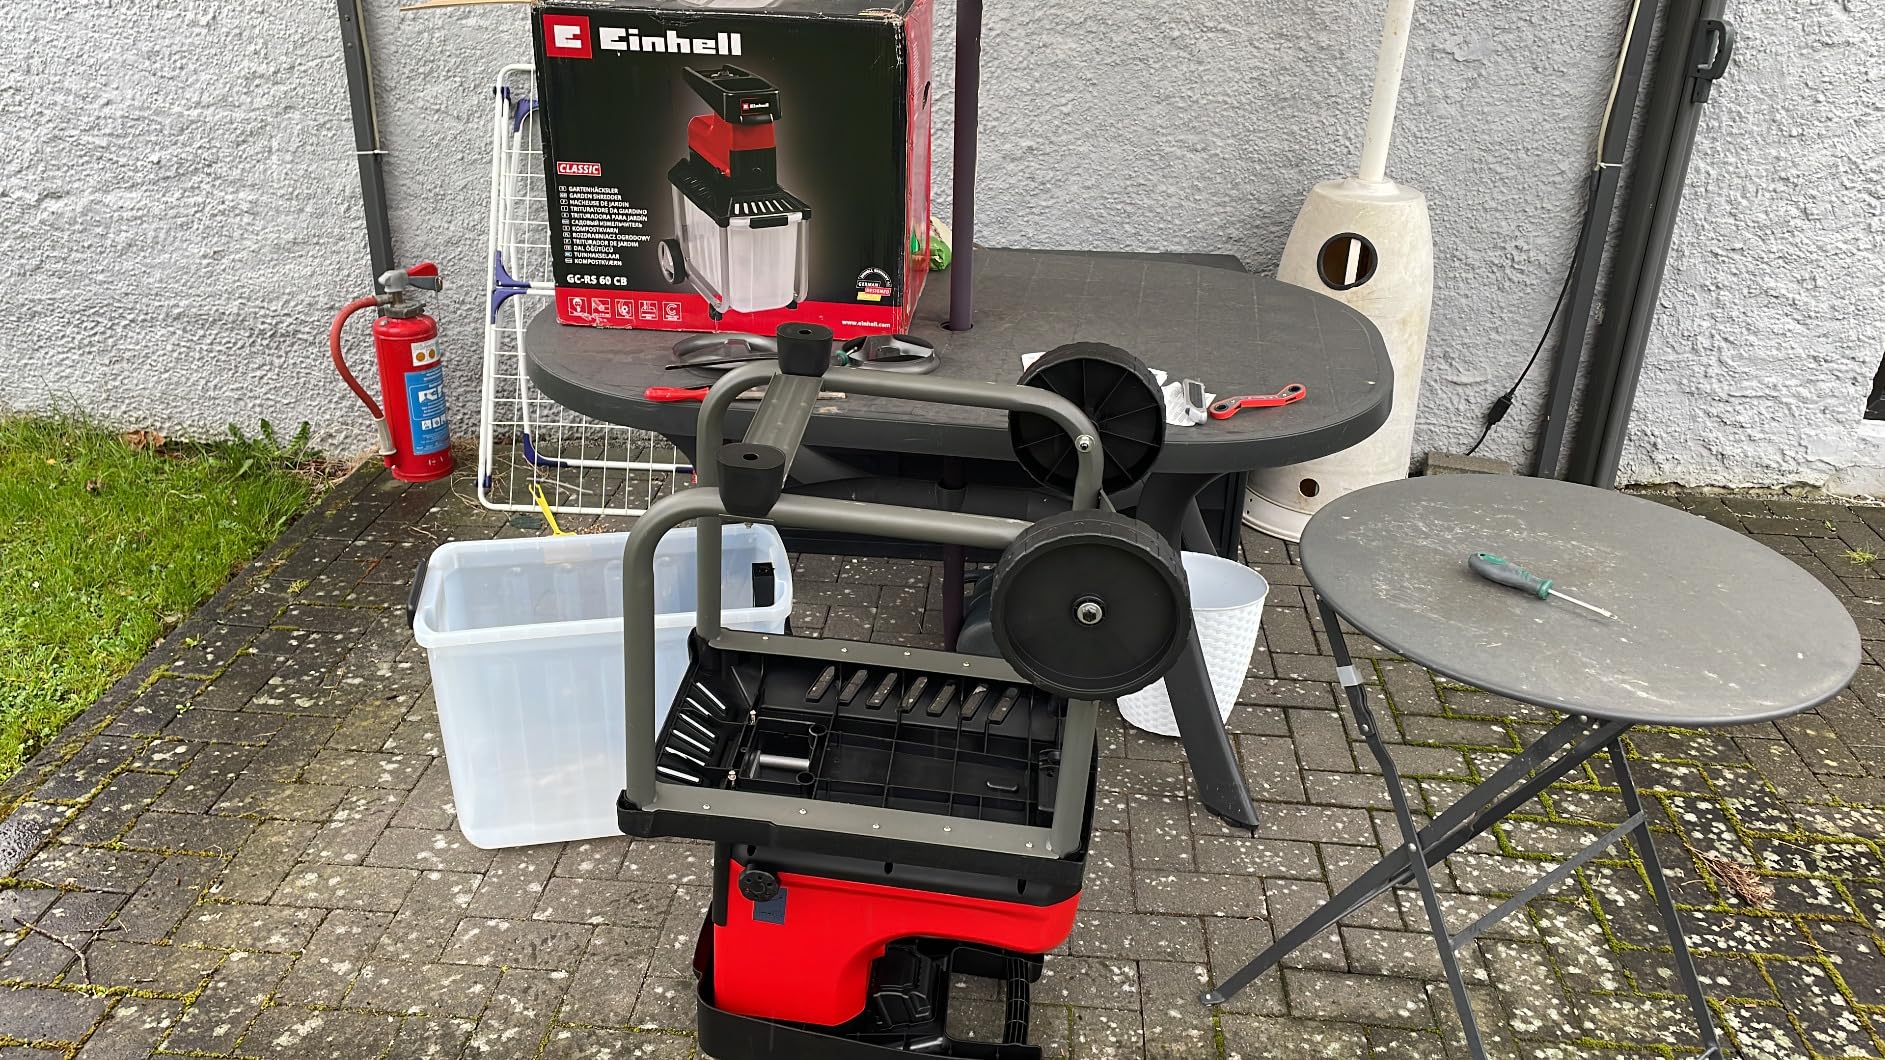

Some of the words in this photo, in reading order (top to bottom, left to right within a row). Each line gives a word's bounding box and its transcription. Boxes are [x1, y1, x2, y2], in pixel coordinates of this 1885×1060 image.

[599, 26, 742, 56] Einhell
[560, 164, 599, 173] CLASSIC
[566, 274, 598, 284] GC-RS
[599, 276, 612, 285] 60
[614, 276, 628, 285] CB
